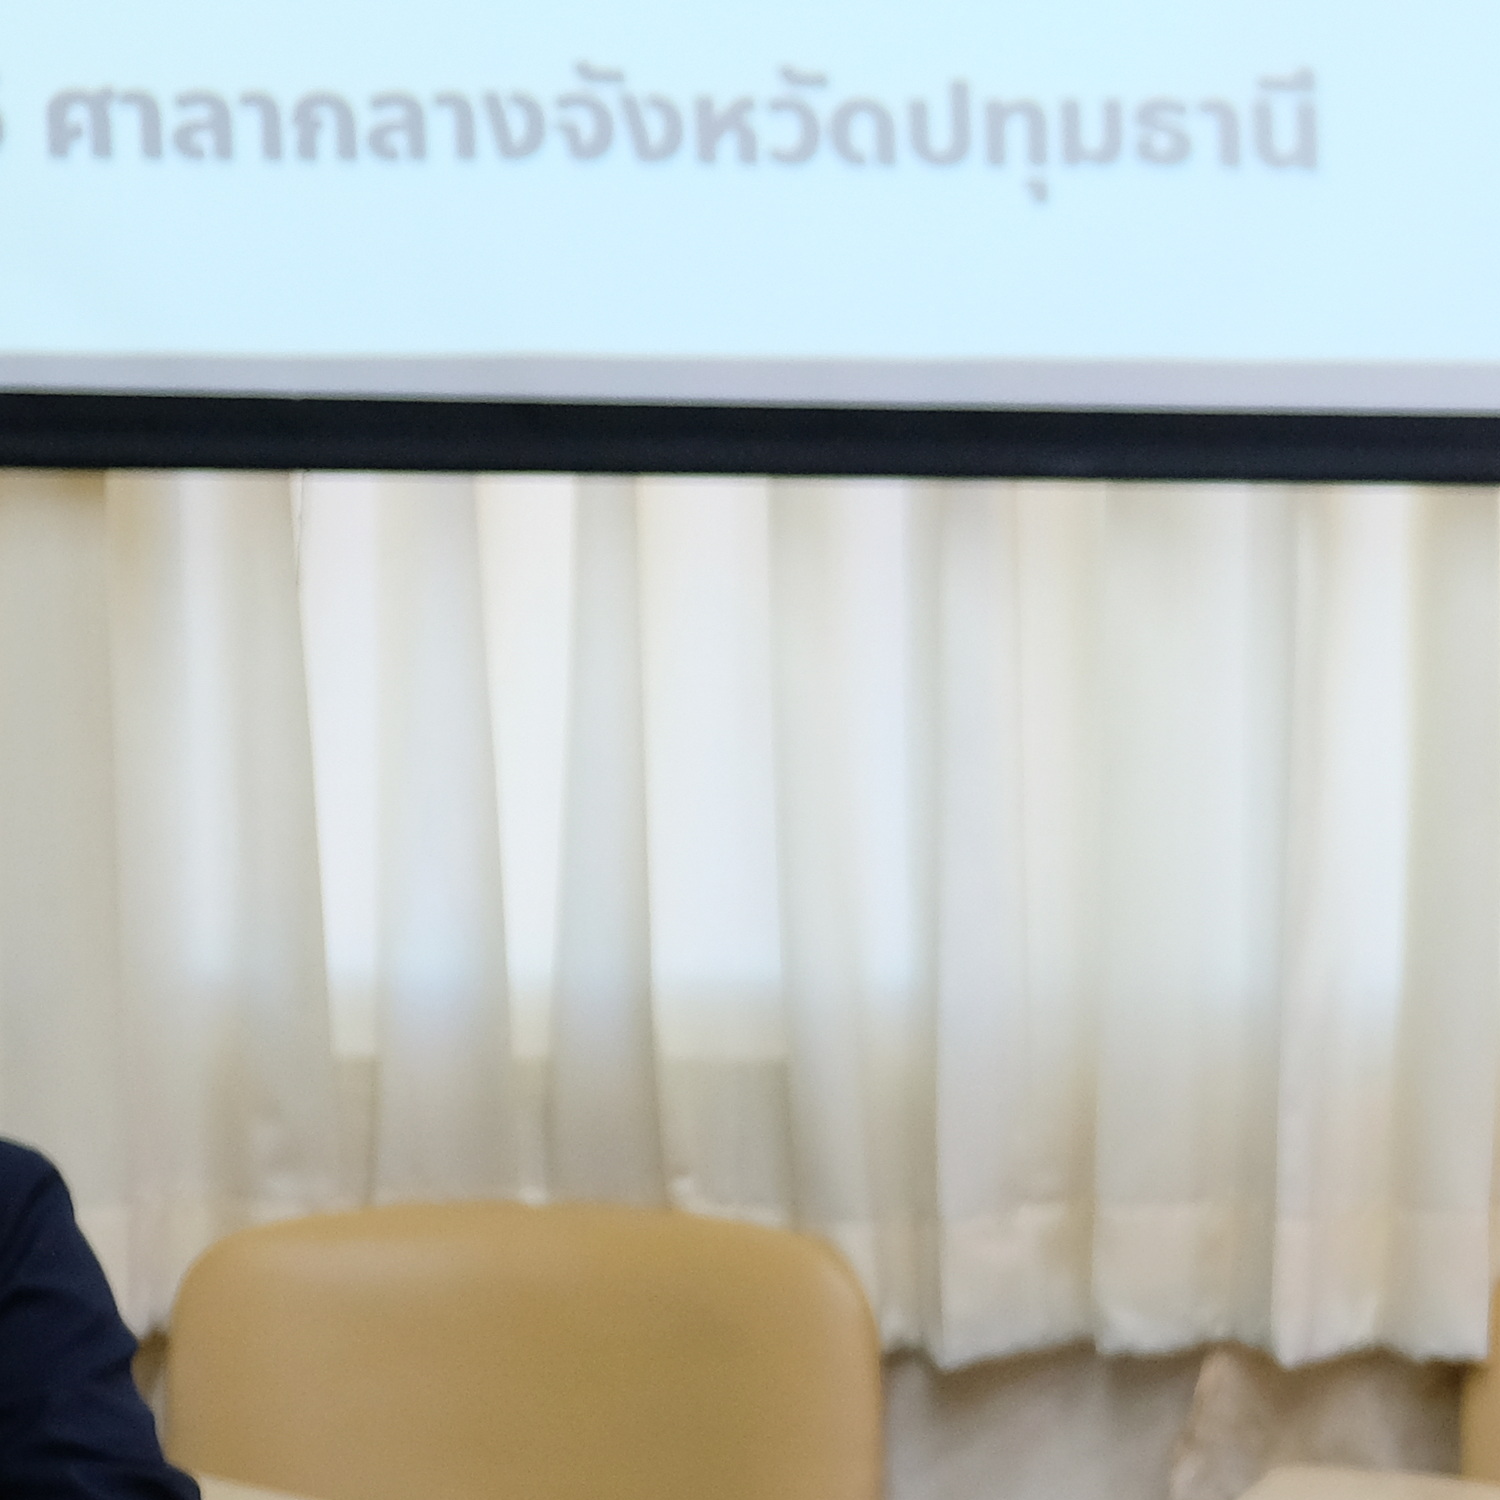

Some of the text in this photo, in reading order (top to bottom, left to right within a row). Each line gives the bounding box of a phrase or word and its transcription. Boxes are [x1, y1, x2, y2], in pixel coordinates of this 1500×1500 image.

[45, 62, 1324, 206] ศาลากลางจังหวัดปทุมธานี
